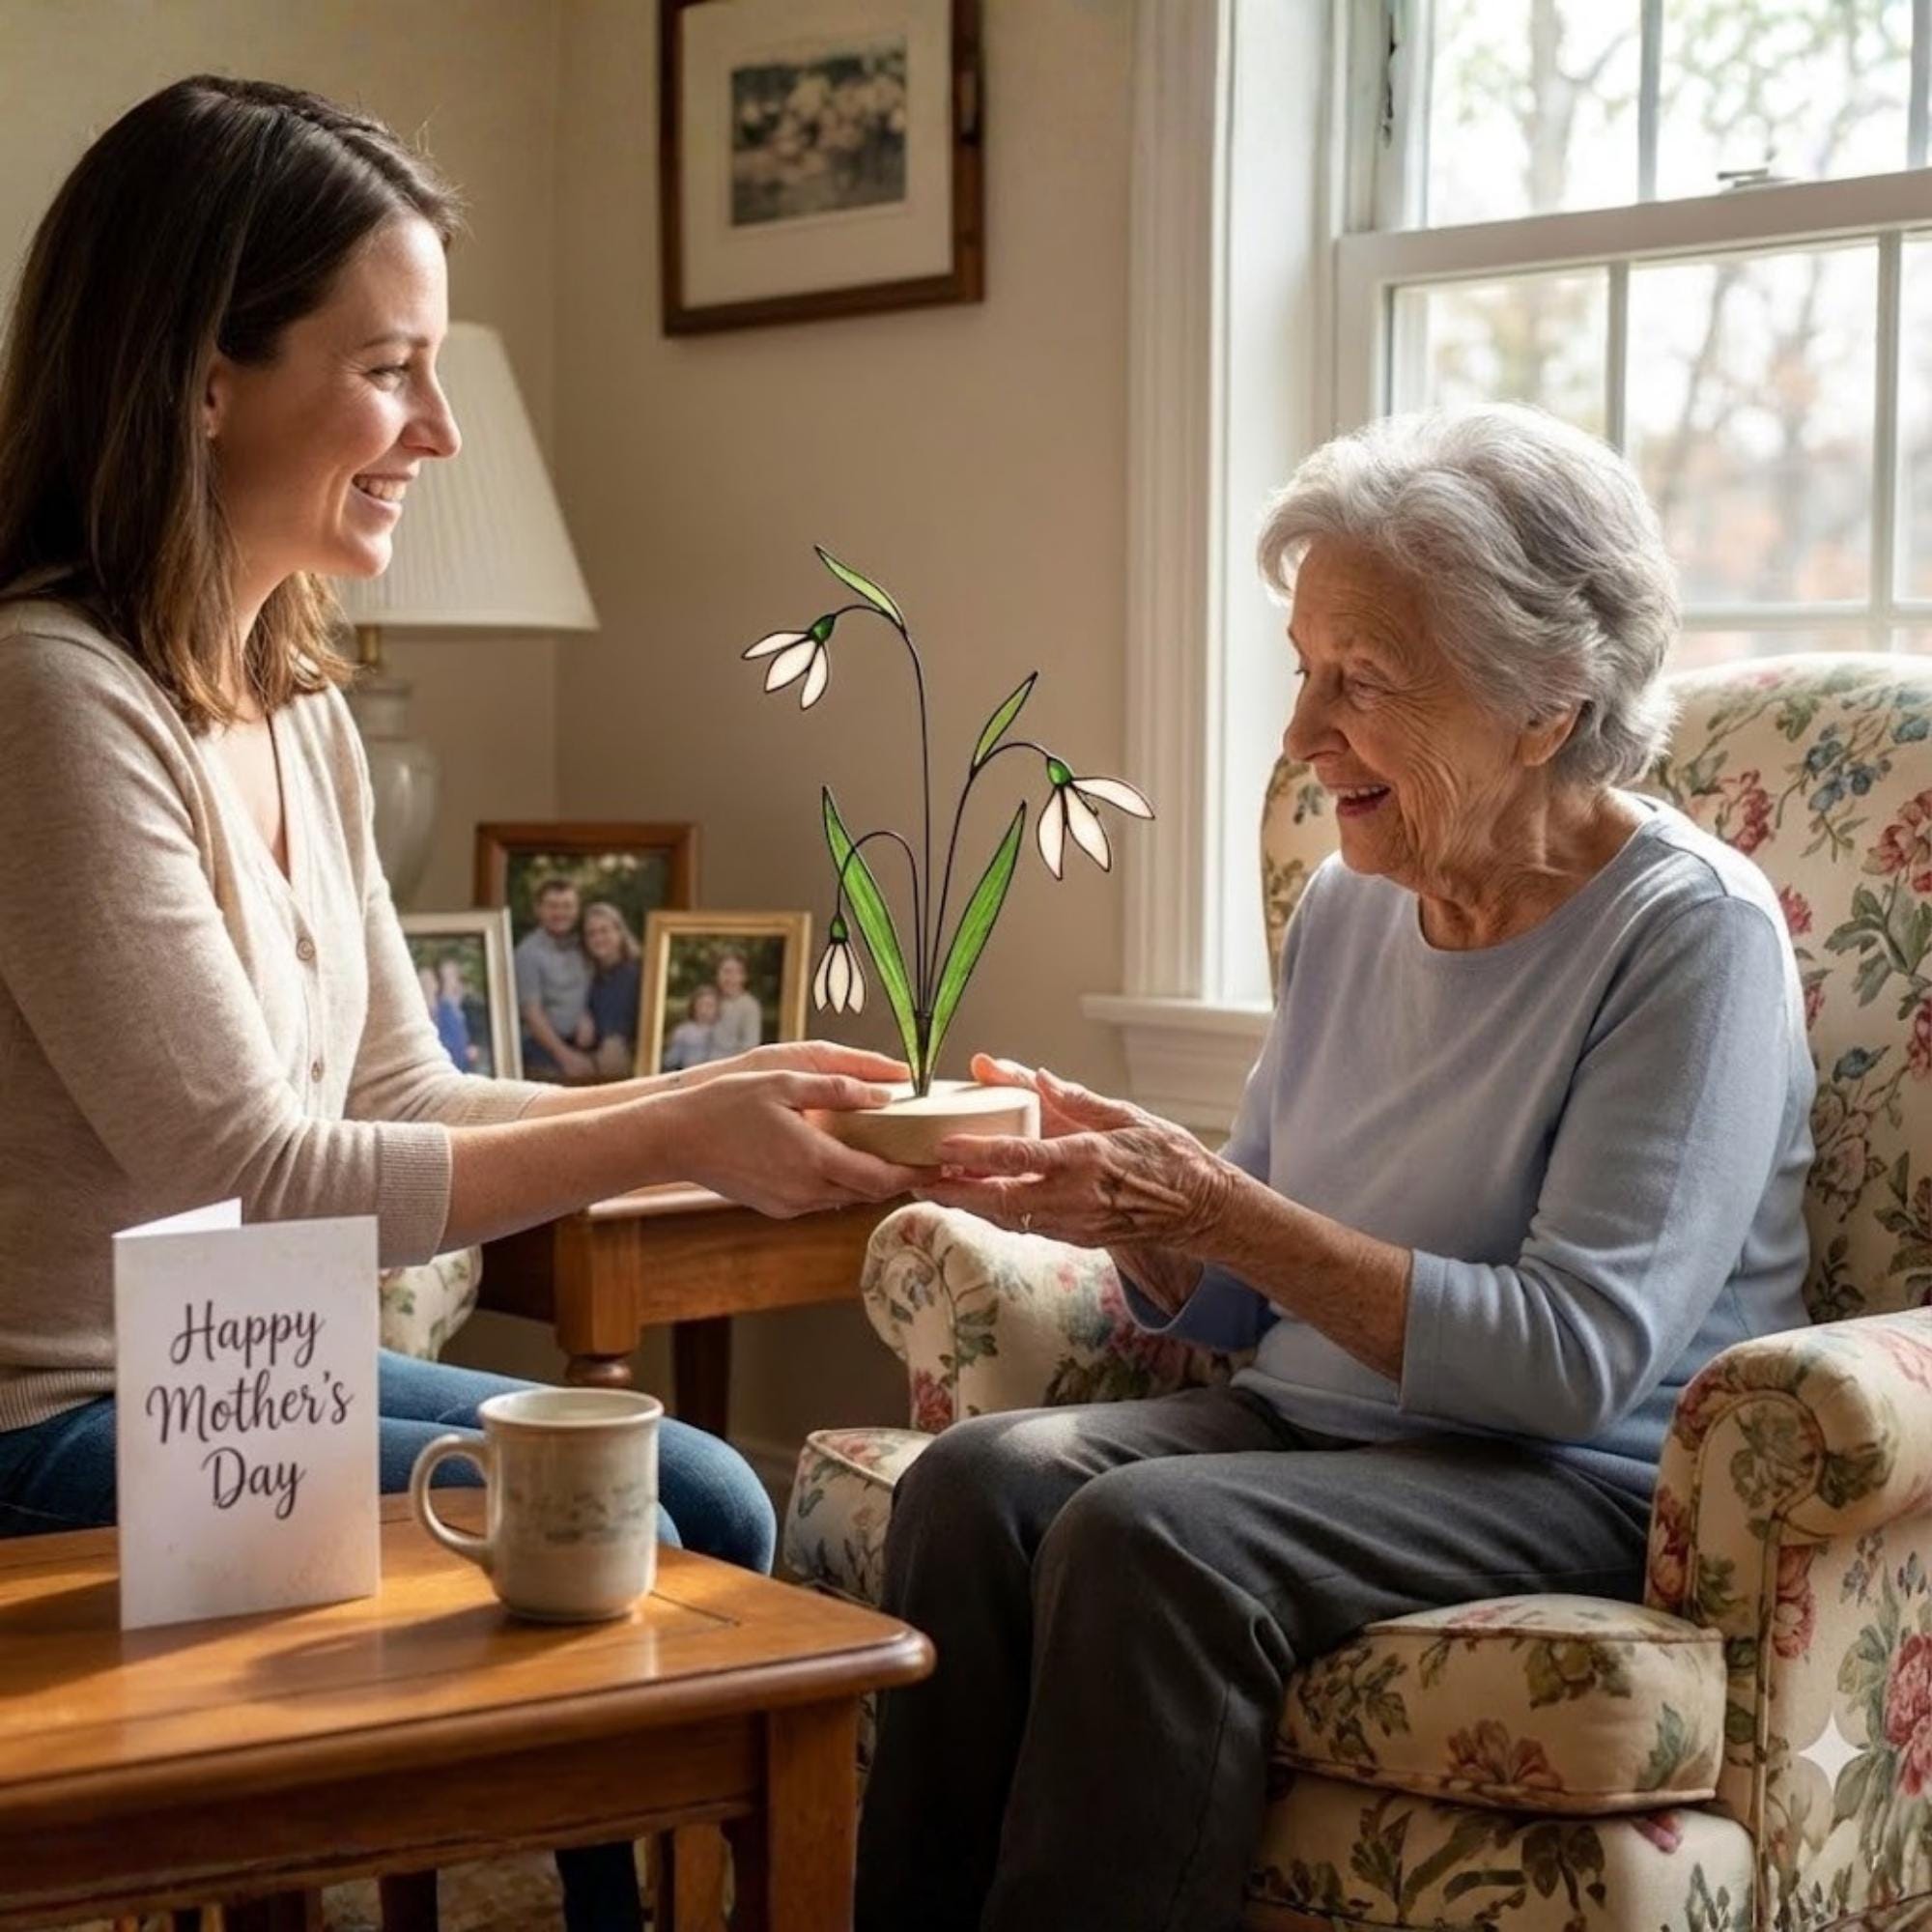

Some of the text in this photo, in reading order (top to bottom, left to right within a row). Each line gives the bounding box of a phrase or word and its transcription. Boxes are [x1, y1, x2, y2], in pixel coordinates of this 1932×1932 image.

[170, 1300, 324, 1369] Happy
[145, 1369, 353, 1444] Mother's
[201, 1446, 306, 1521] Day
